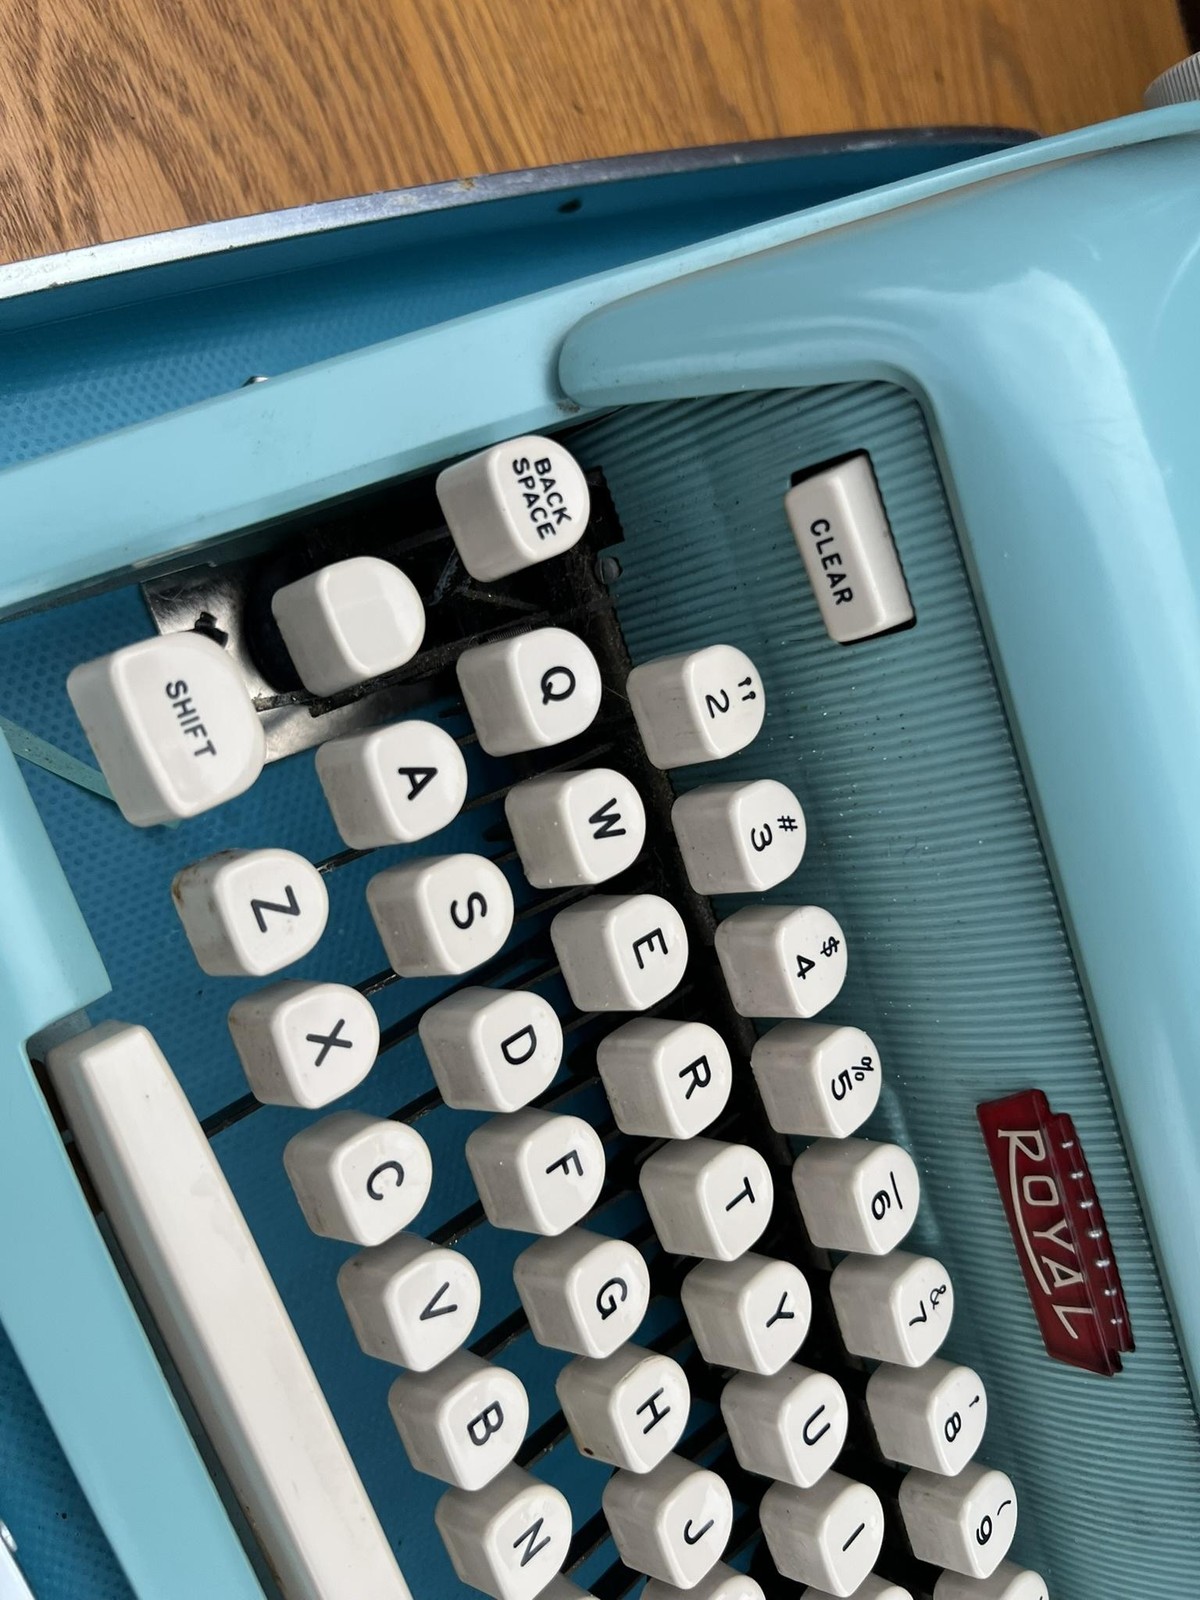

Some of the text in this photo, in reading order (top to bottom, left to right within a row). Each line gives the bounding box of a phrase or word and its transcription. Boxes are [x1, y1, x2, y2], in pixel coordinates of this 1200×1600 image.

[511, 456, 557, 541] SPACE
[532, 456, 574, 528] BACK
[808, 517, 854, 607] CLEAR
[540, 665, 577, 706] Q
[704, 688, 730, 719] 2
[164, 679, 217, 757] SHIFT
[397, 766, 439, 802] A
[588, 797, 627, 840] W
[750, 822, 773, 853] 3
[776, 815, 799, 832] #
[249, 884, 301, 934] Z
[449, 891, 488, 930] S
[632, 927, 669, 970] E
[796, 954, 816, 980] 4
[819, 935, 841, 958] $
[305, 1018, 353, 1068] X
[500, 1024, 538, 1066] D
[678, 1054, 712, 1100] R
[831, 1069, 853, 1101] 5
[850, 1056, 875, 1082] %
[366, 1160, 405, 1201] C
[545, 1149, 584, 1177] F
[725, 1176, 756, 1212] T
[871, 1189, 891, 1221] 6
[996, 1127, 1095, 1341] ROYAL
[419, 1281, 459, 1322] V
[595, 1277, 628, 1321] G
[765, 1291, 795, 1329] Y
[908, 1300, 928, 1327] 7
[929, 1284, 947, 1311] &
[466, 1400, 505, 1447] B
[635, 1387, 671, 1435] H
[802, 1404, 831, 1447] U
[944, 1411, 962, 1443] 8
[512, 1517, 552, 1568] N
[683, 1519, 715, 1546] J
[975, 1514, 993, 1546] 9
